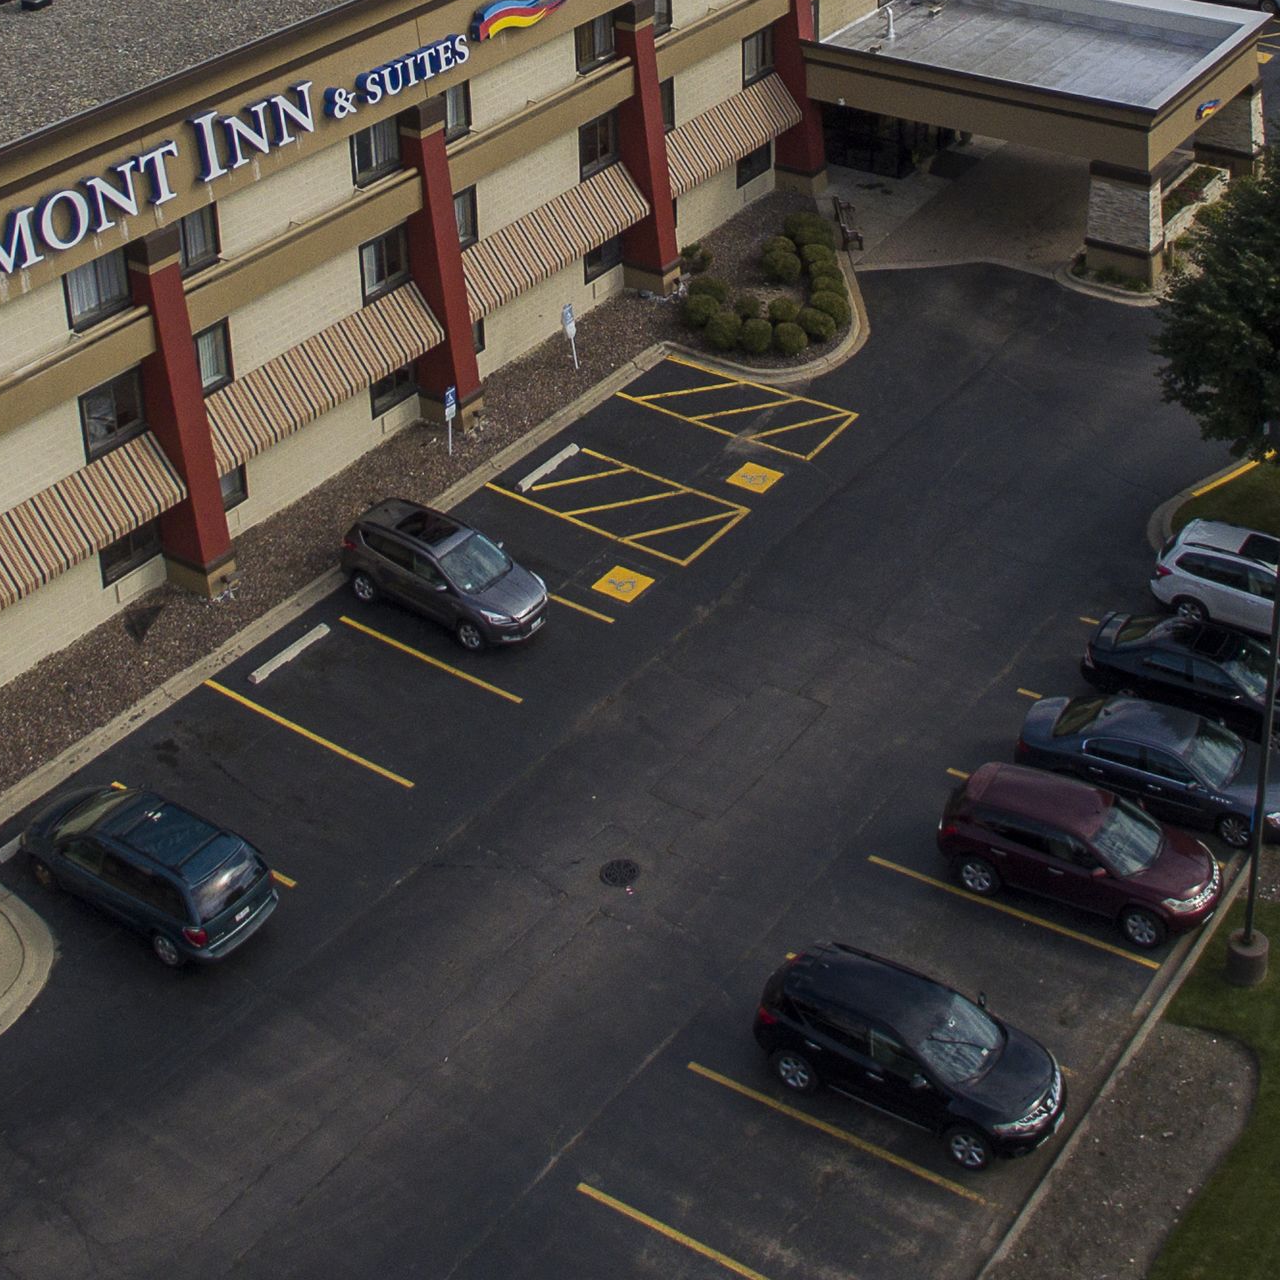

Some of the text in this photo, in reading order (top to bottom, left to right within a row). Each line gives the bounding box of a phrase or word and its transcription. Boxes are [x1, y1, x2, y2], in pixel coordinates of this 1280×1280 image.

[190, 79, 316, 183] INN
[331, 86, 358, 119] &
[362, 32, 470, 106] SUITES
